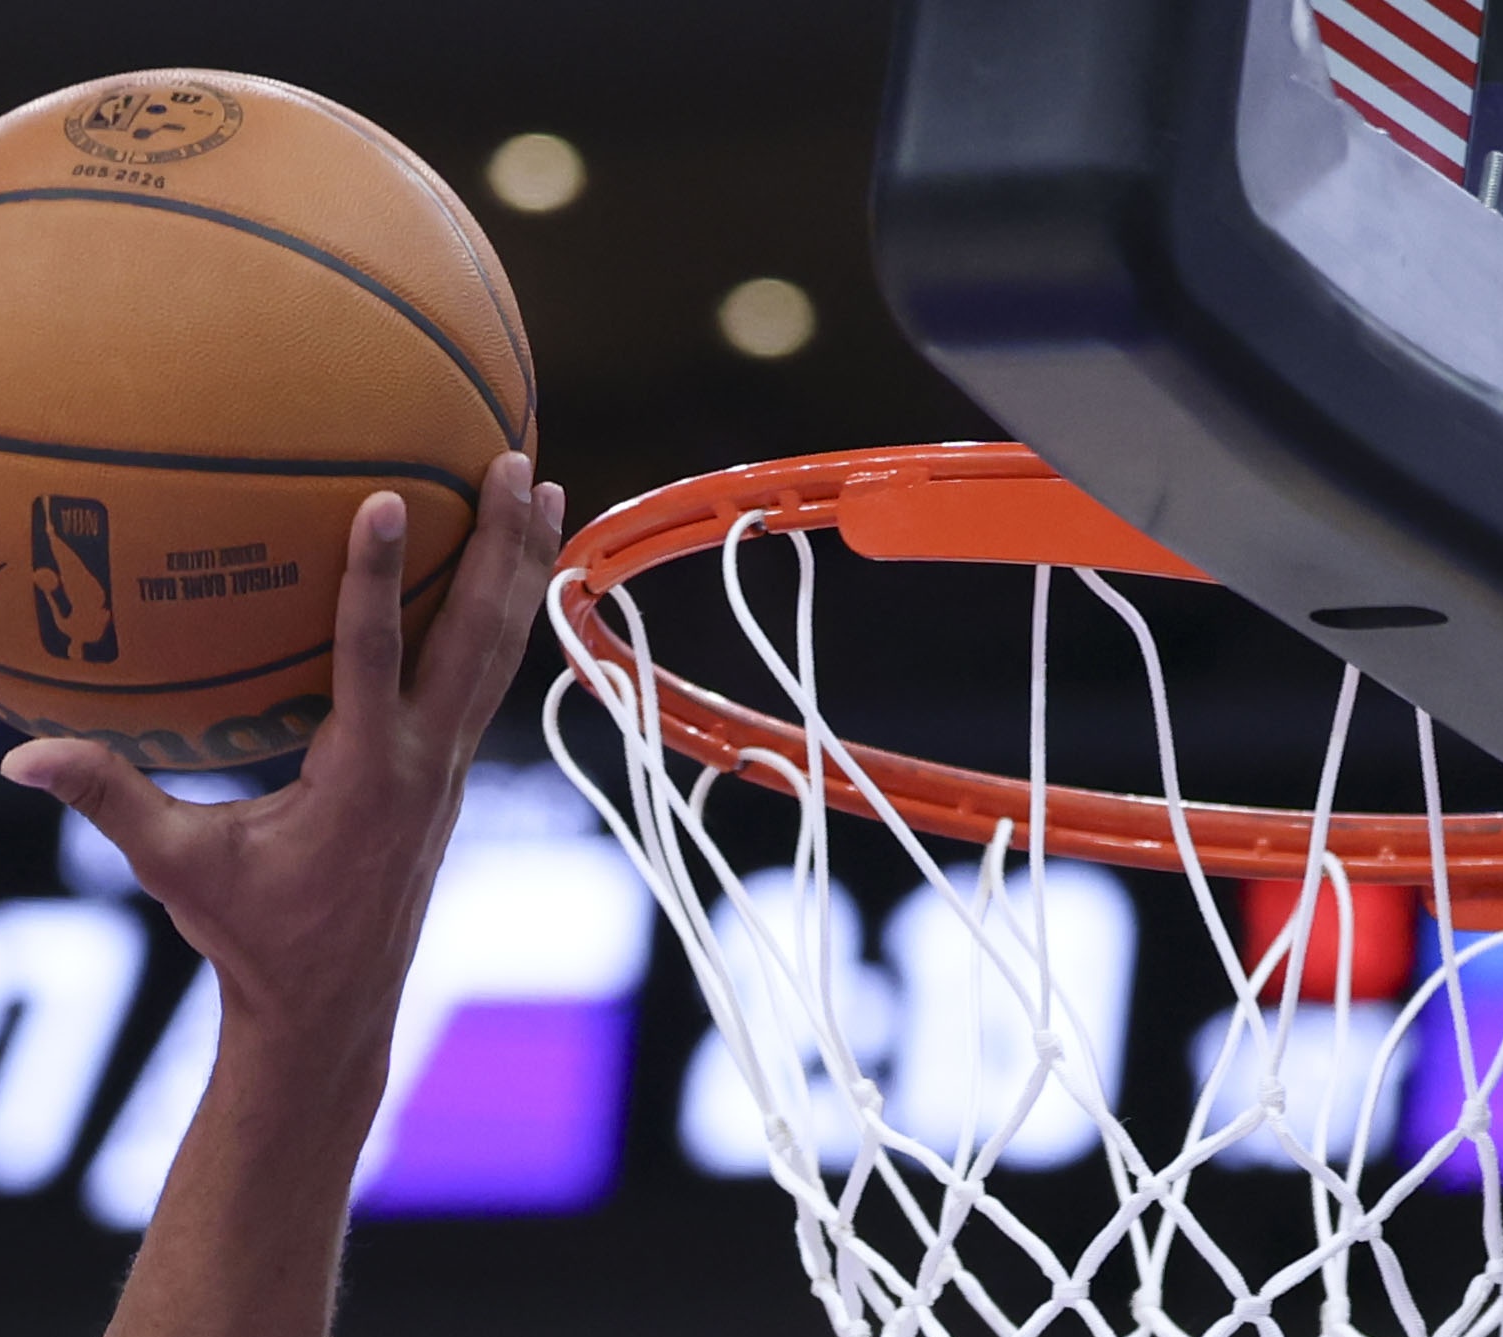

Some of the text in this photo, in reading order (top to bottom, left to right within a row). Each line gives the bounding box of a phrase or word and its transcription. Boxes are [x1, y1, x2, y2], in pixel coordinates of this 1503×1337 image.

[60, 506, 100, 537] NBA
[136, 577, 177, 602] BALL
[230, 561, 299, 596] OFFICIAL
